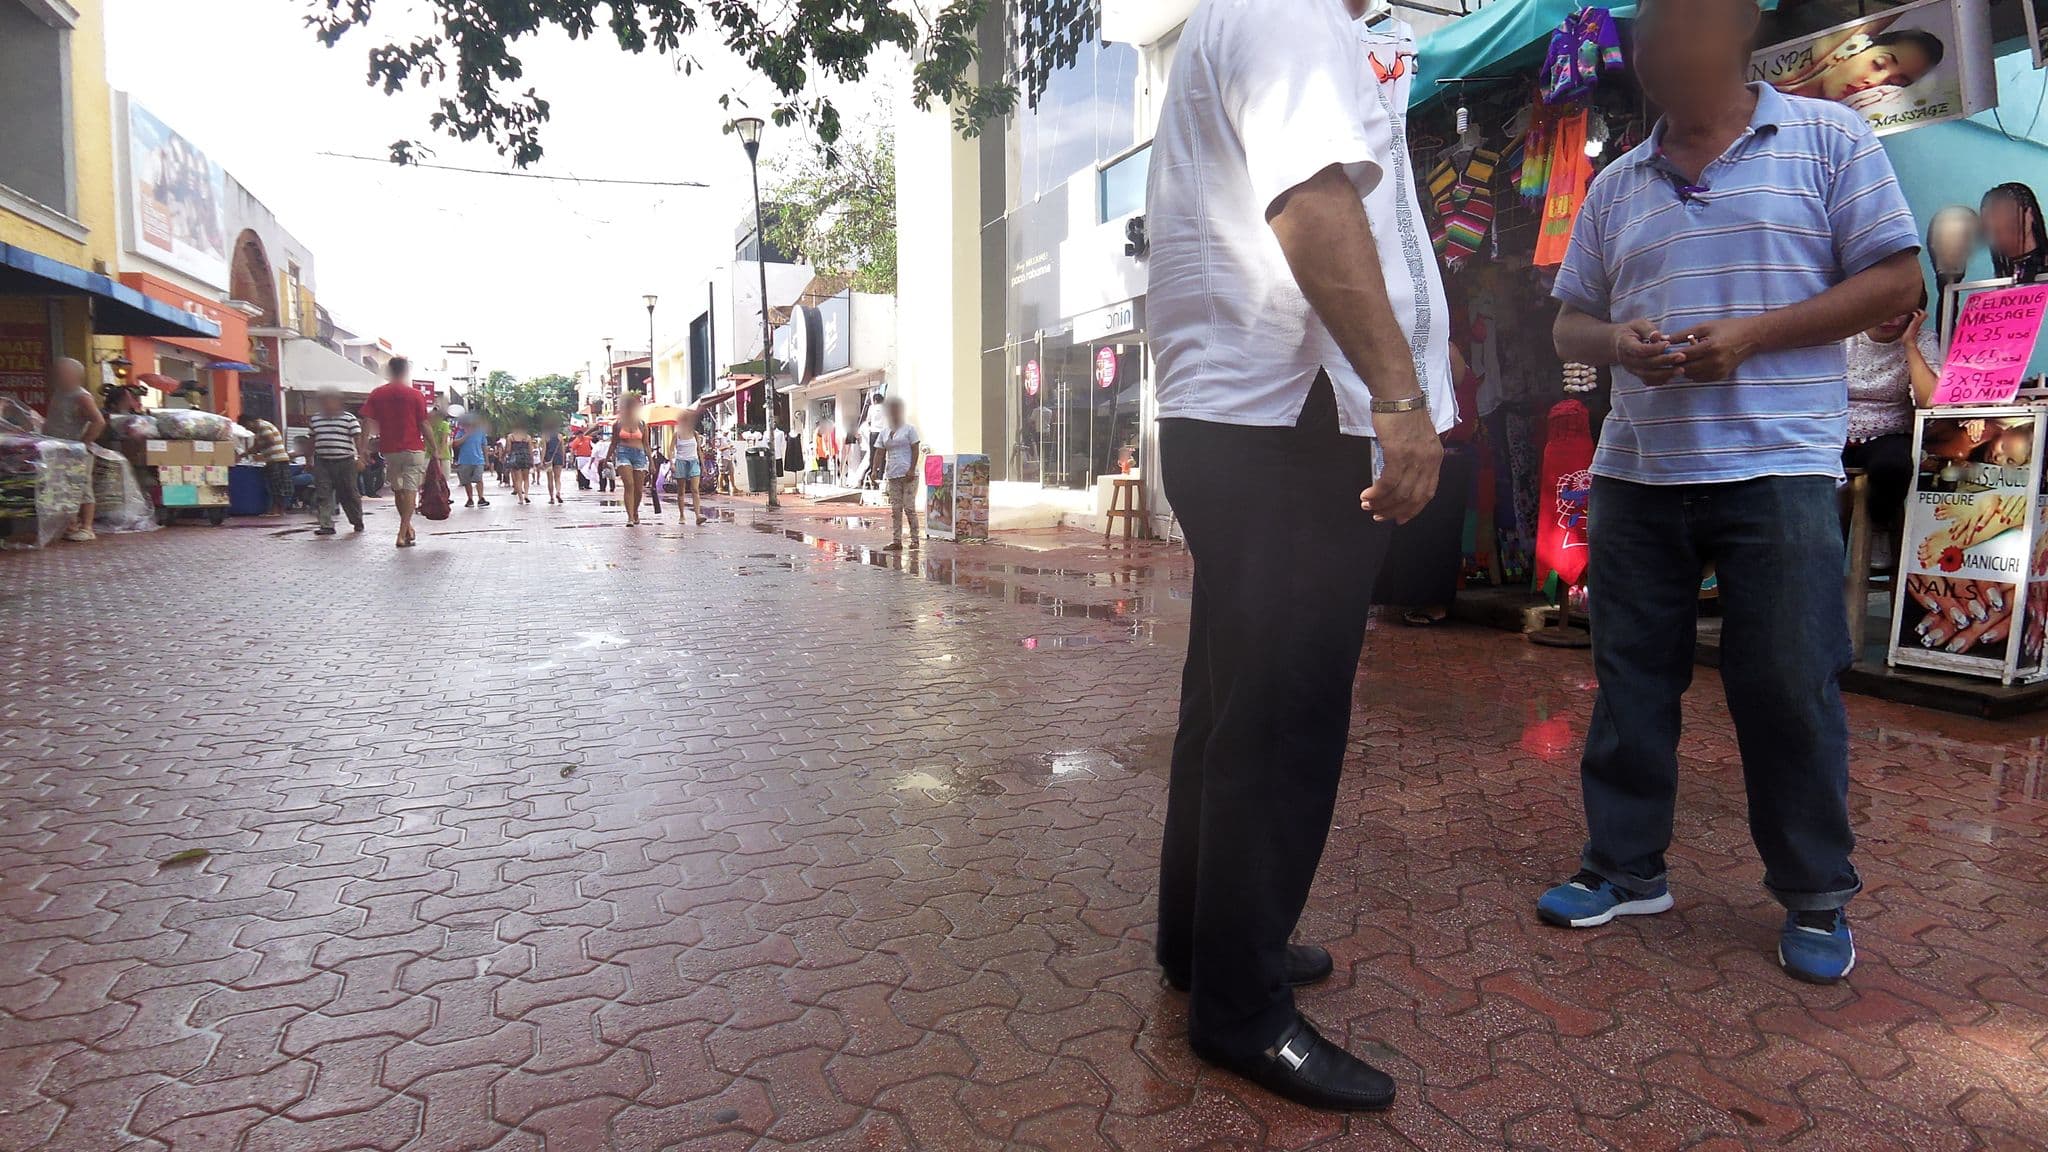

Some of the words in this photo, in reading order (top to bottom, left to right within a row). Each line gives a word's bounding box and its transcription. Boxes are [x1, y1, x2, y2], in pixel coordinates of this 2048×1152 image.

[1771, 46, 1813, 76] SPA
[1873, 103, 1949, 128] MASSAGE
[1966, 292, 2045, 311] RELAXING
[1962, 308, 2037, 326] MASSAGE
[1949, 386, 1972, 403] 80
[1976, 387, 2009, 399] MIN
[1919, 492, 1974, 506] PEDICURE
